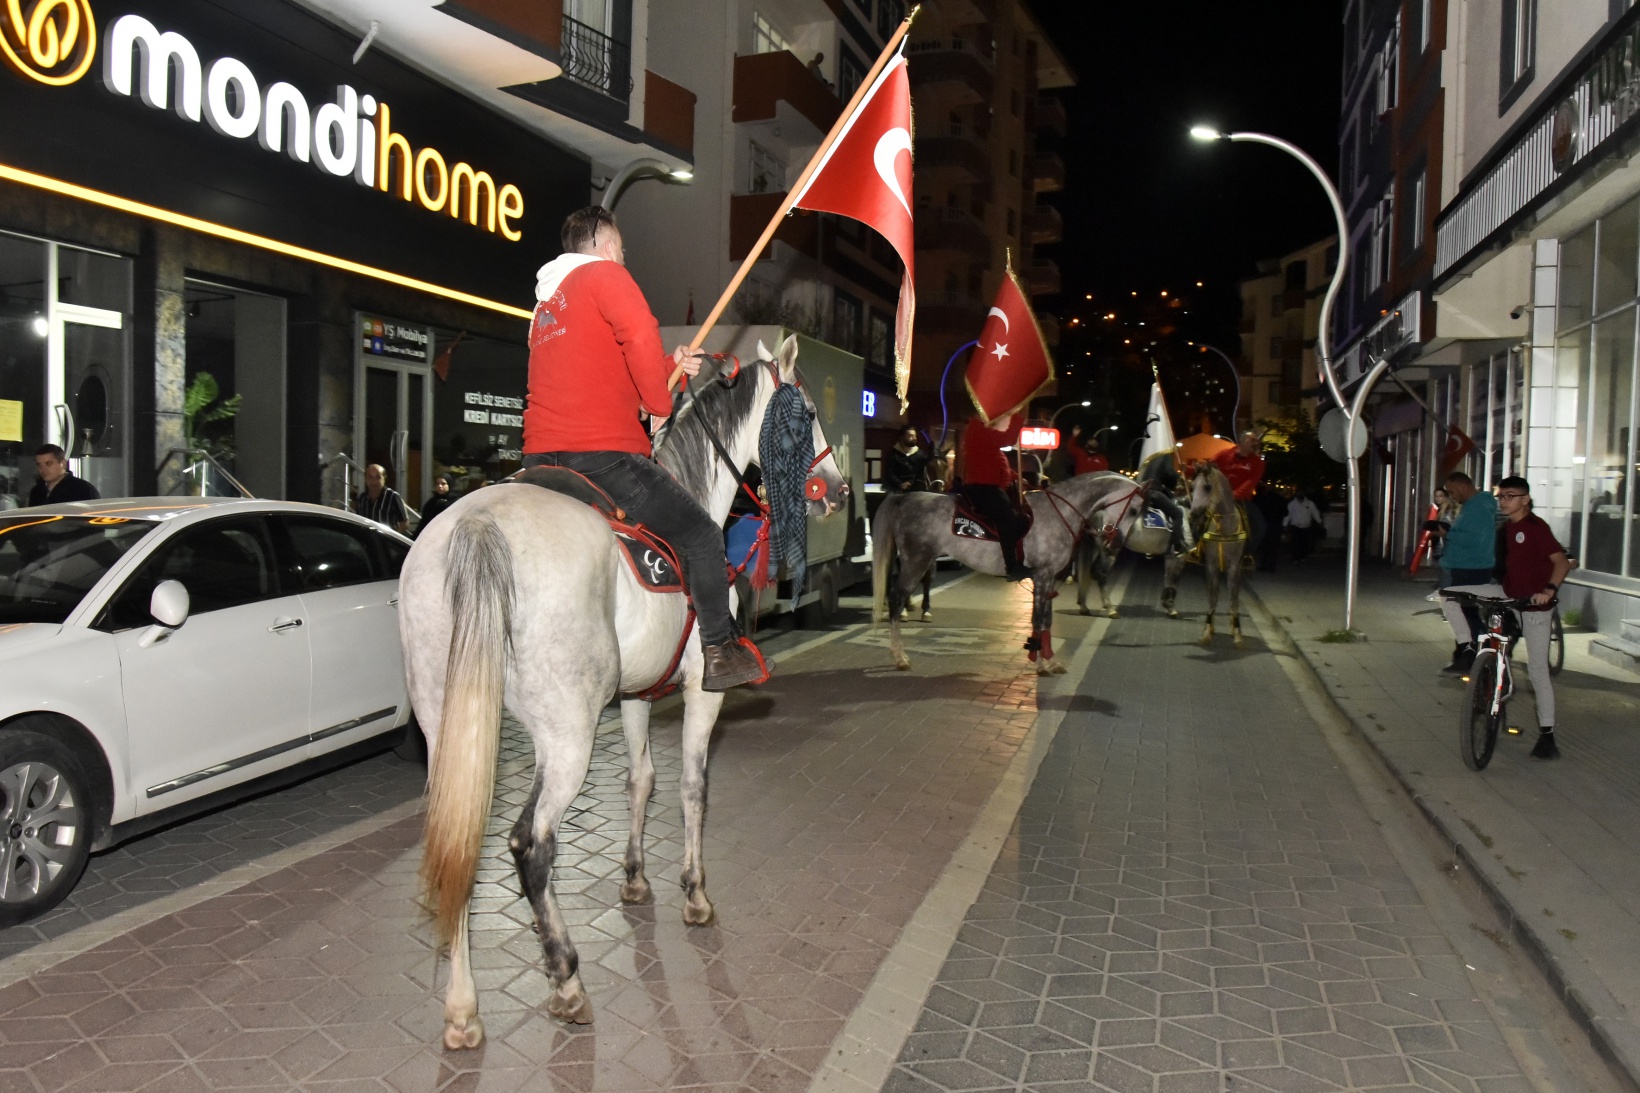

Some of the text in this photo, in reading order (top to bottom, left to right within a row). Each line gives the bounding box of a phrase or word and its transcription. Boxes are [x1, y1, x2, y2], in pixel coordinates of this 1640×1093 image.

[104, 14, 524, 242] mondihome
[396, 326, 428, 345] Mobilya
[463, 409, 490, 425] KREDİ
